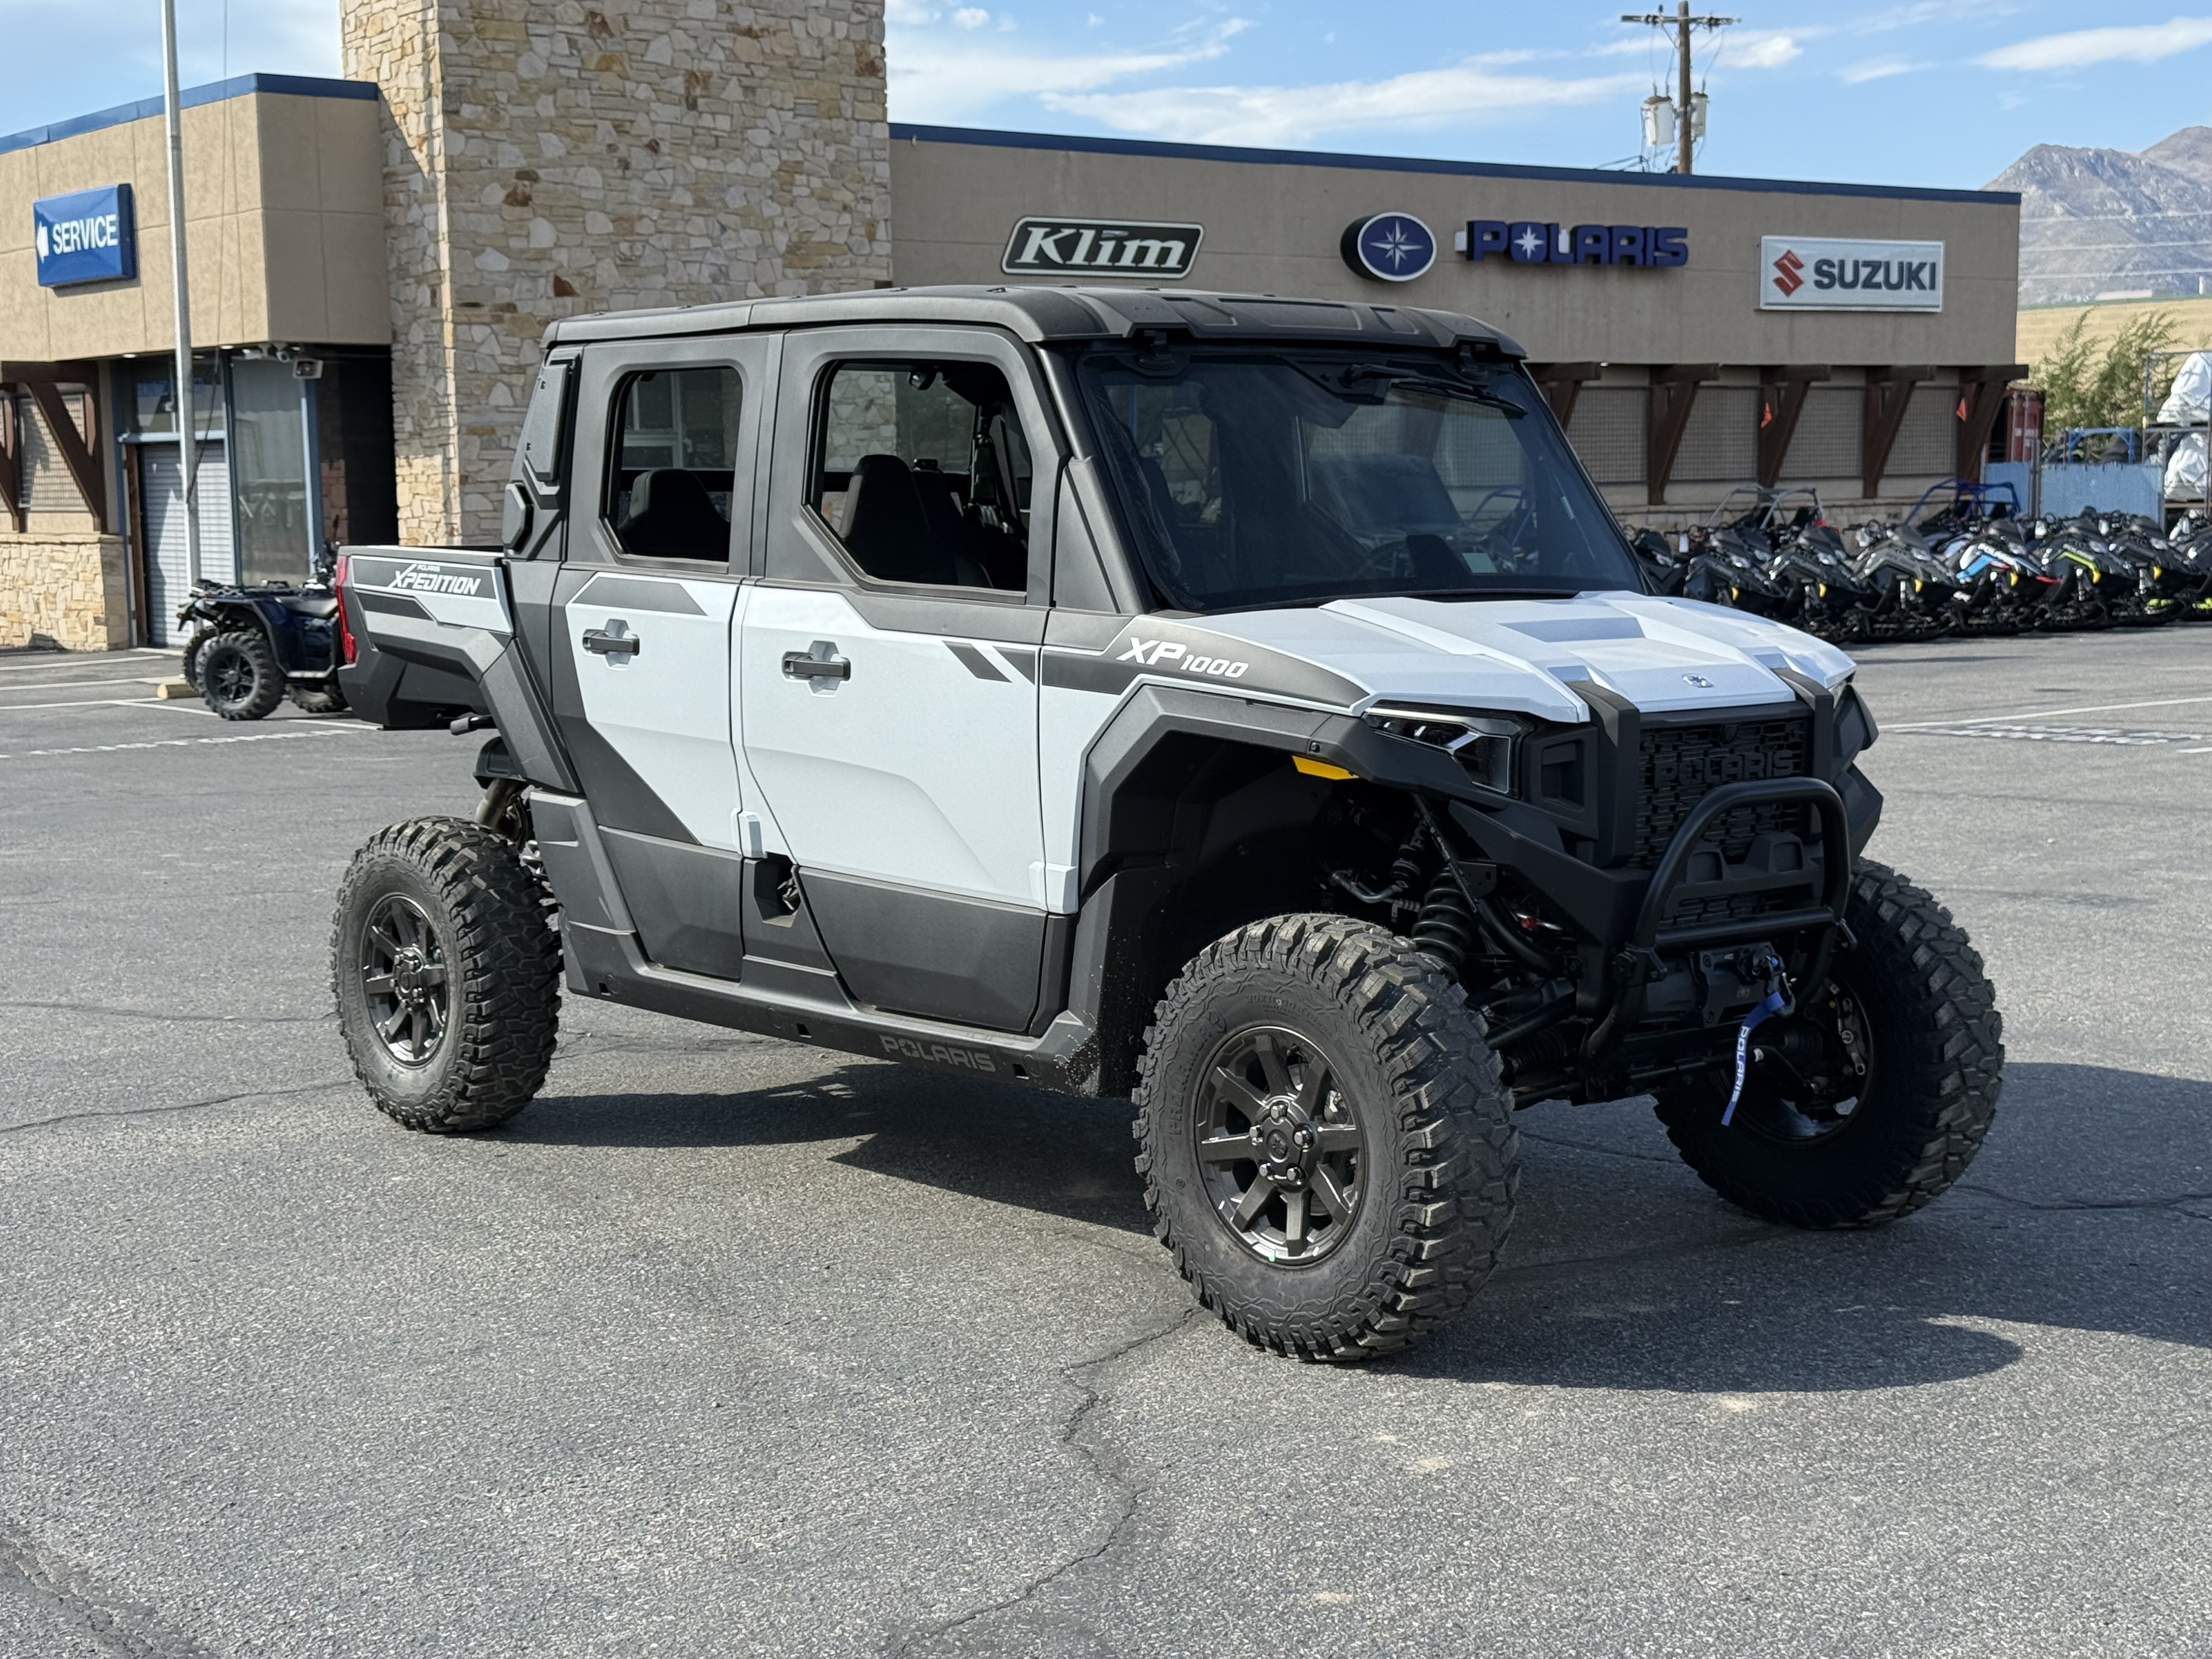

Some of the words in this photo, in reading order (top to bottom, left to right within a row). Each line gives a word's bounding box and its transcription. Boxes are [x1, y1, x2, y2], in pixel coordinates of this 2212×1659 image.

[53, 213, 119, 255] SERVICE
[1468, 221, 1688, 266] POLARIS
[1813, 258, 1936, 291] SUZUKI
[387, 563, 482, 595] XPEDITION
[417, 564, 441, 572] POLARIS
[1116, 636, 1187, 665] XP
[1180, 654, 1249, 678] 1000
[1654, 749, 1793, 789] POLARIS
[879, 1034, 996, 1073] POLARIS
[1732, 1025, 1751, 1102] POLARIS
